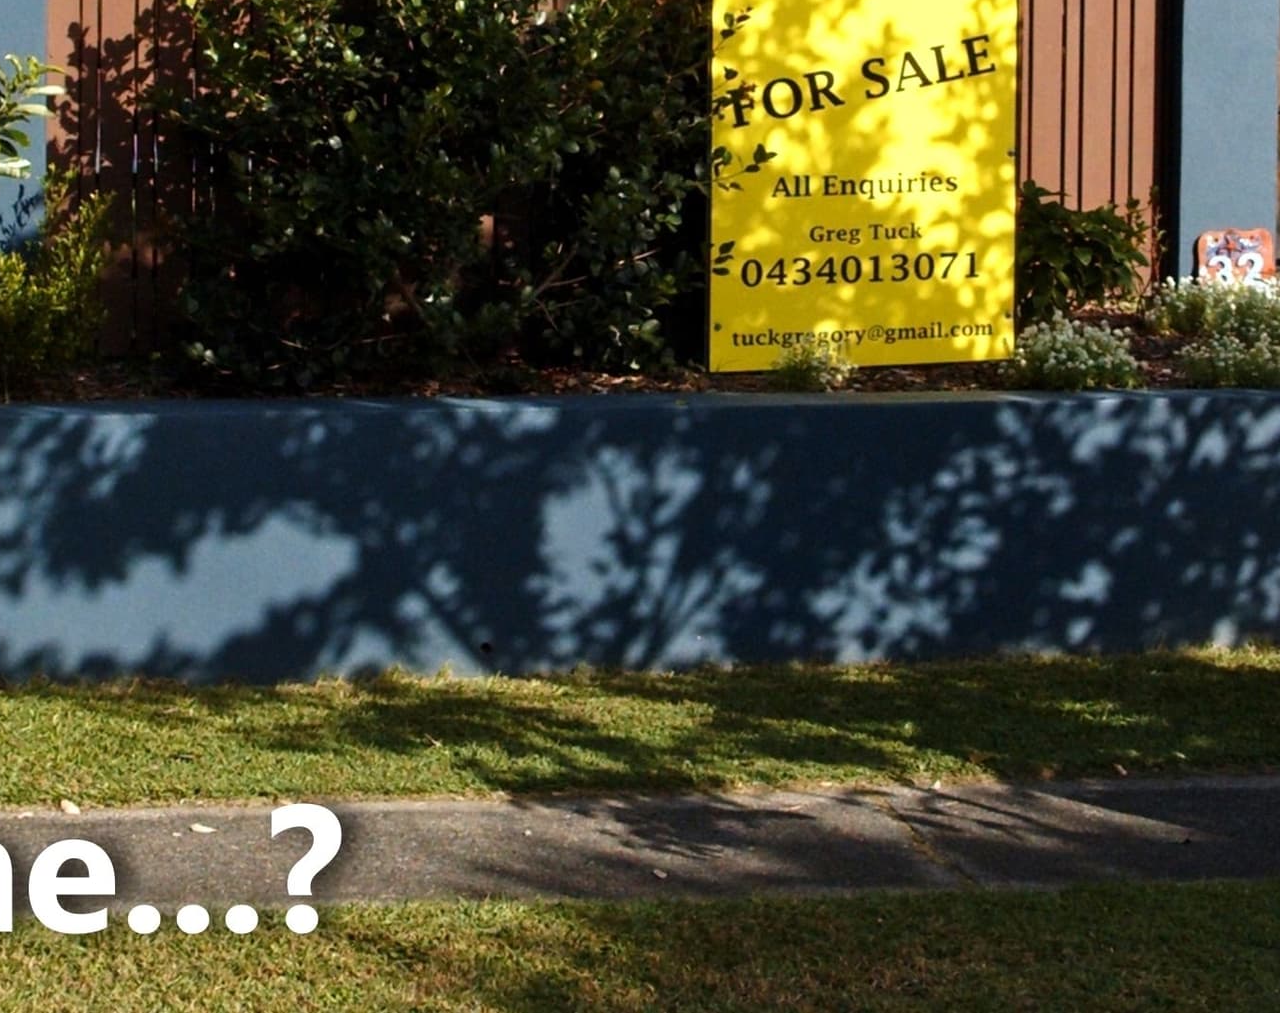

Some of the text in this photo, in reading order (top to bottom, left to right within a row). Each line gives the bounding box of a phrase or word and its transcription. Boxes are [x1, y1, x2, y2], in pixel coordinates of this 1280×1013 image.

[726, 34, 997, 128] FOR SALE
[772, 172, 959, 200] All Enquiries
[810, 223, 923, 244] Greg Tuck
[740, 251, 980, 287] 0434013071
[732, 321, 994, 349] tuckgregory@gmail.com
